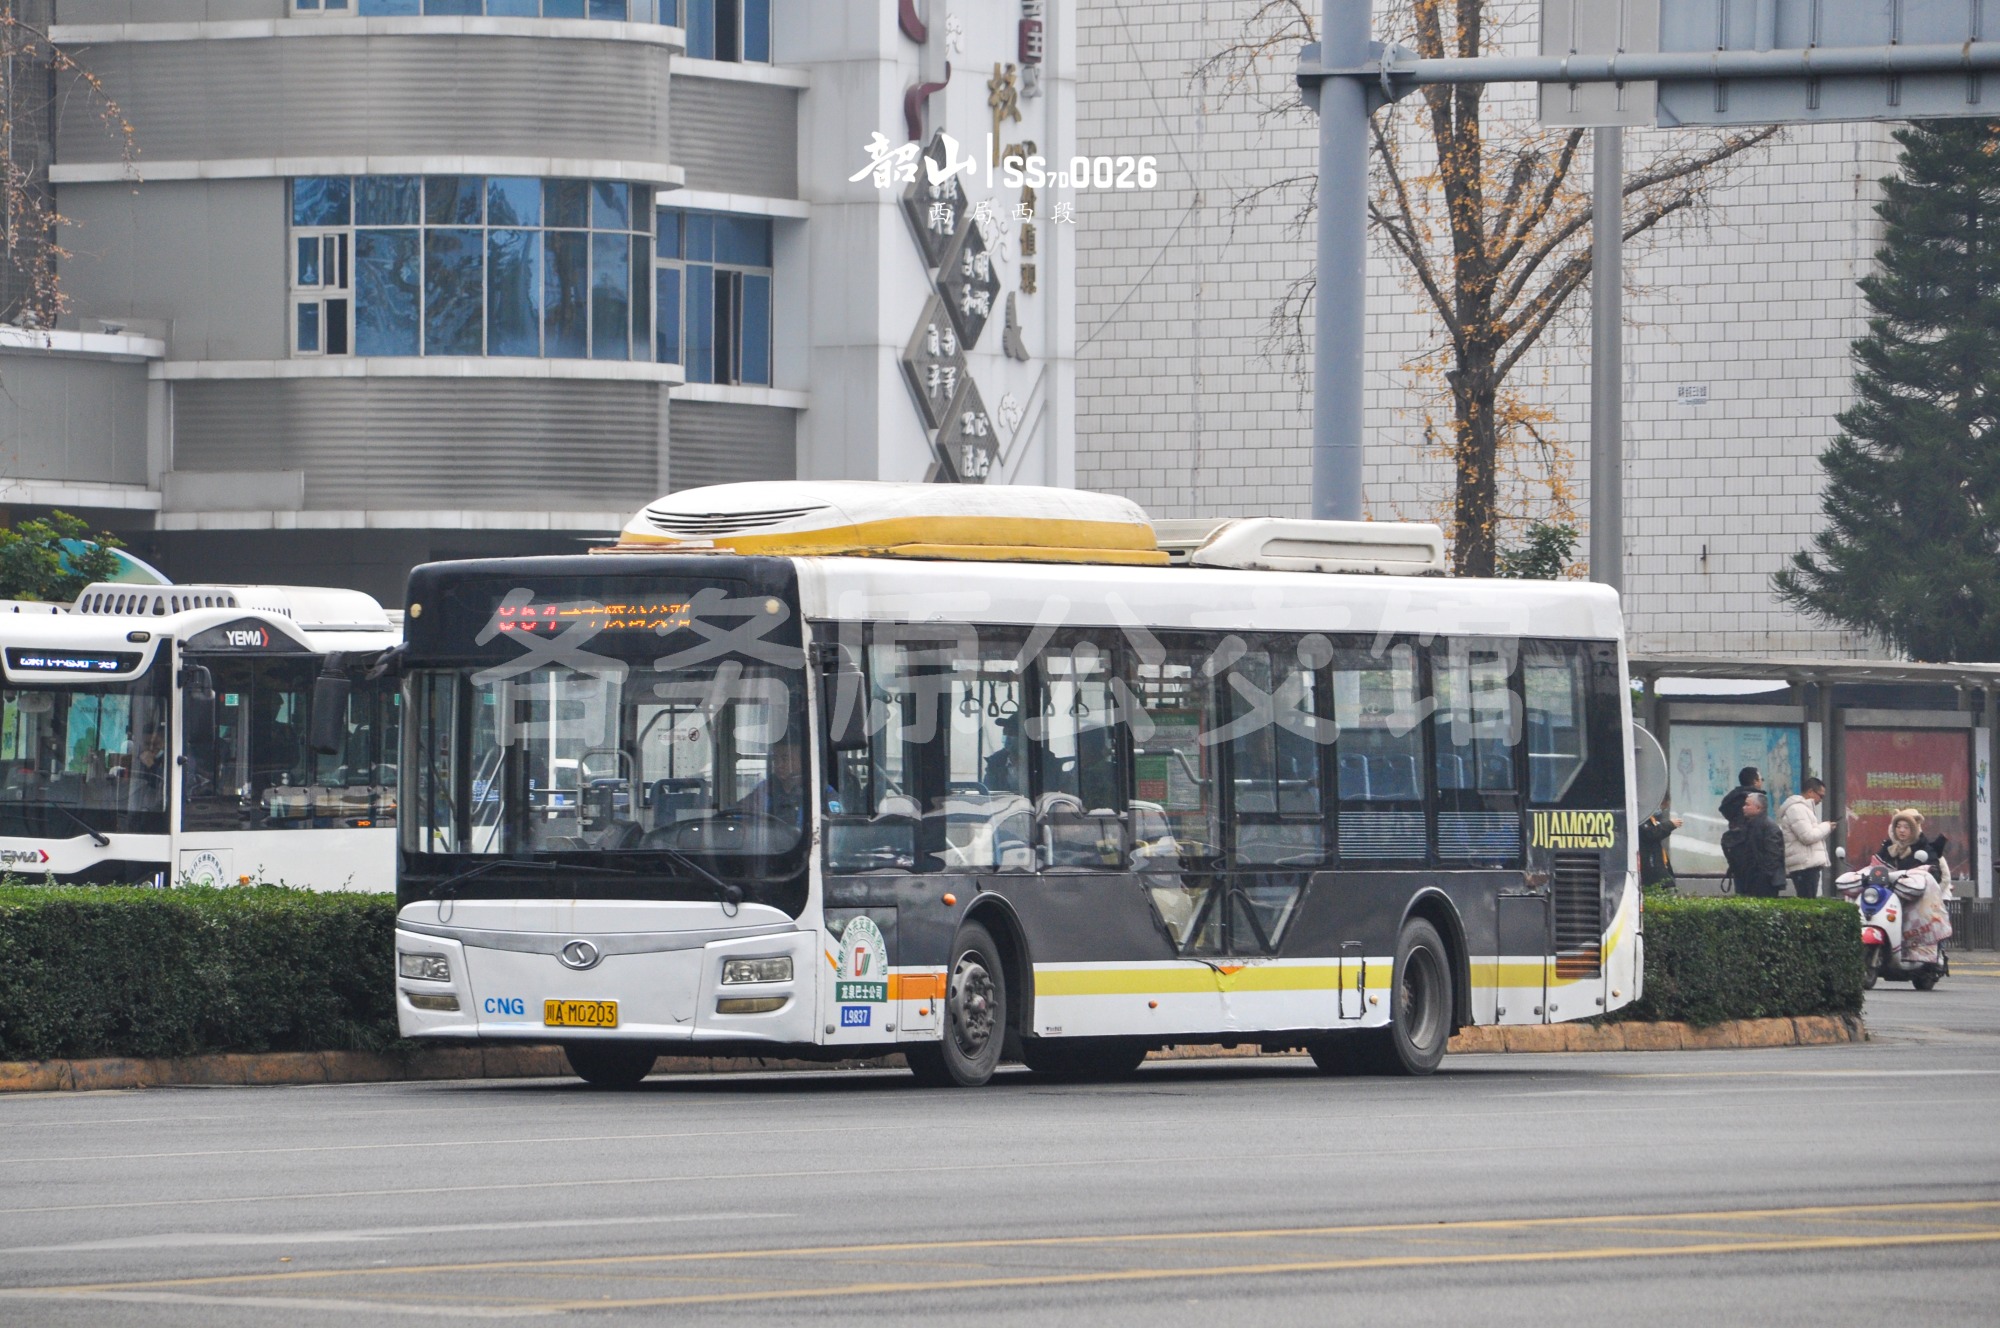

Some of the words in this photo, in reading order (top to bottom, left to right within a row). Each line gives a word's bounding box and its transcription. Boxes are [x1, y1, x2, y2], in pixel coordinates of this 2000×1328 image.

[226, 630, 261, 646] YEMA
[1531, 811, 1615, 849] 川AM0203
[0, 850, 38, 863] EMA
[841, 984, 883, 1000] 龙泉巴士公司
[484, 998, 525, 1015] CNG
[844, 1009, 868, 1024] L9837
